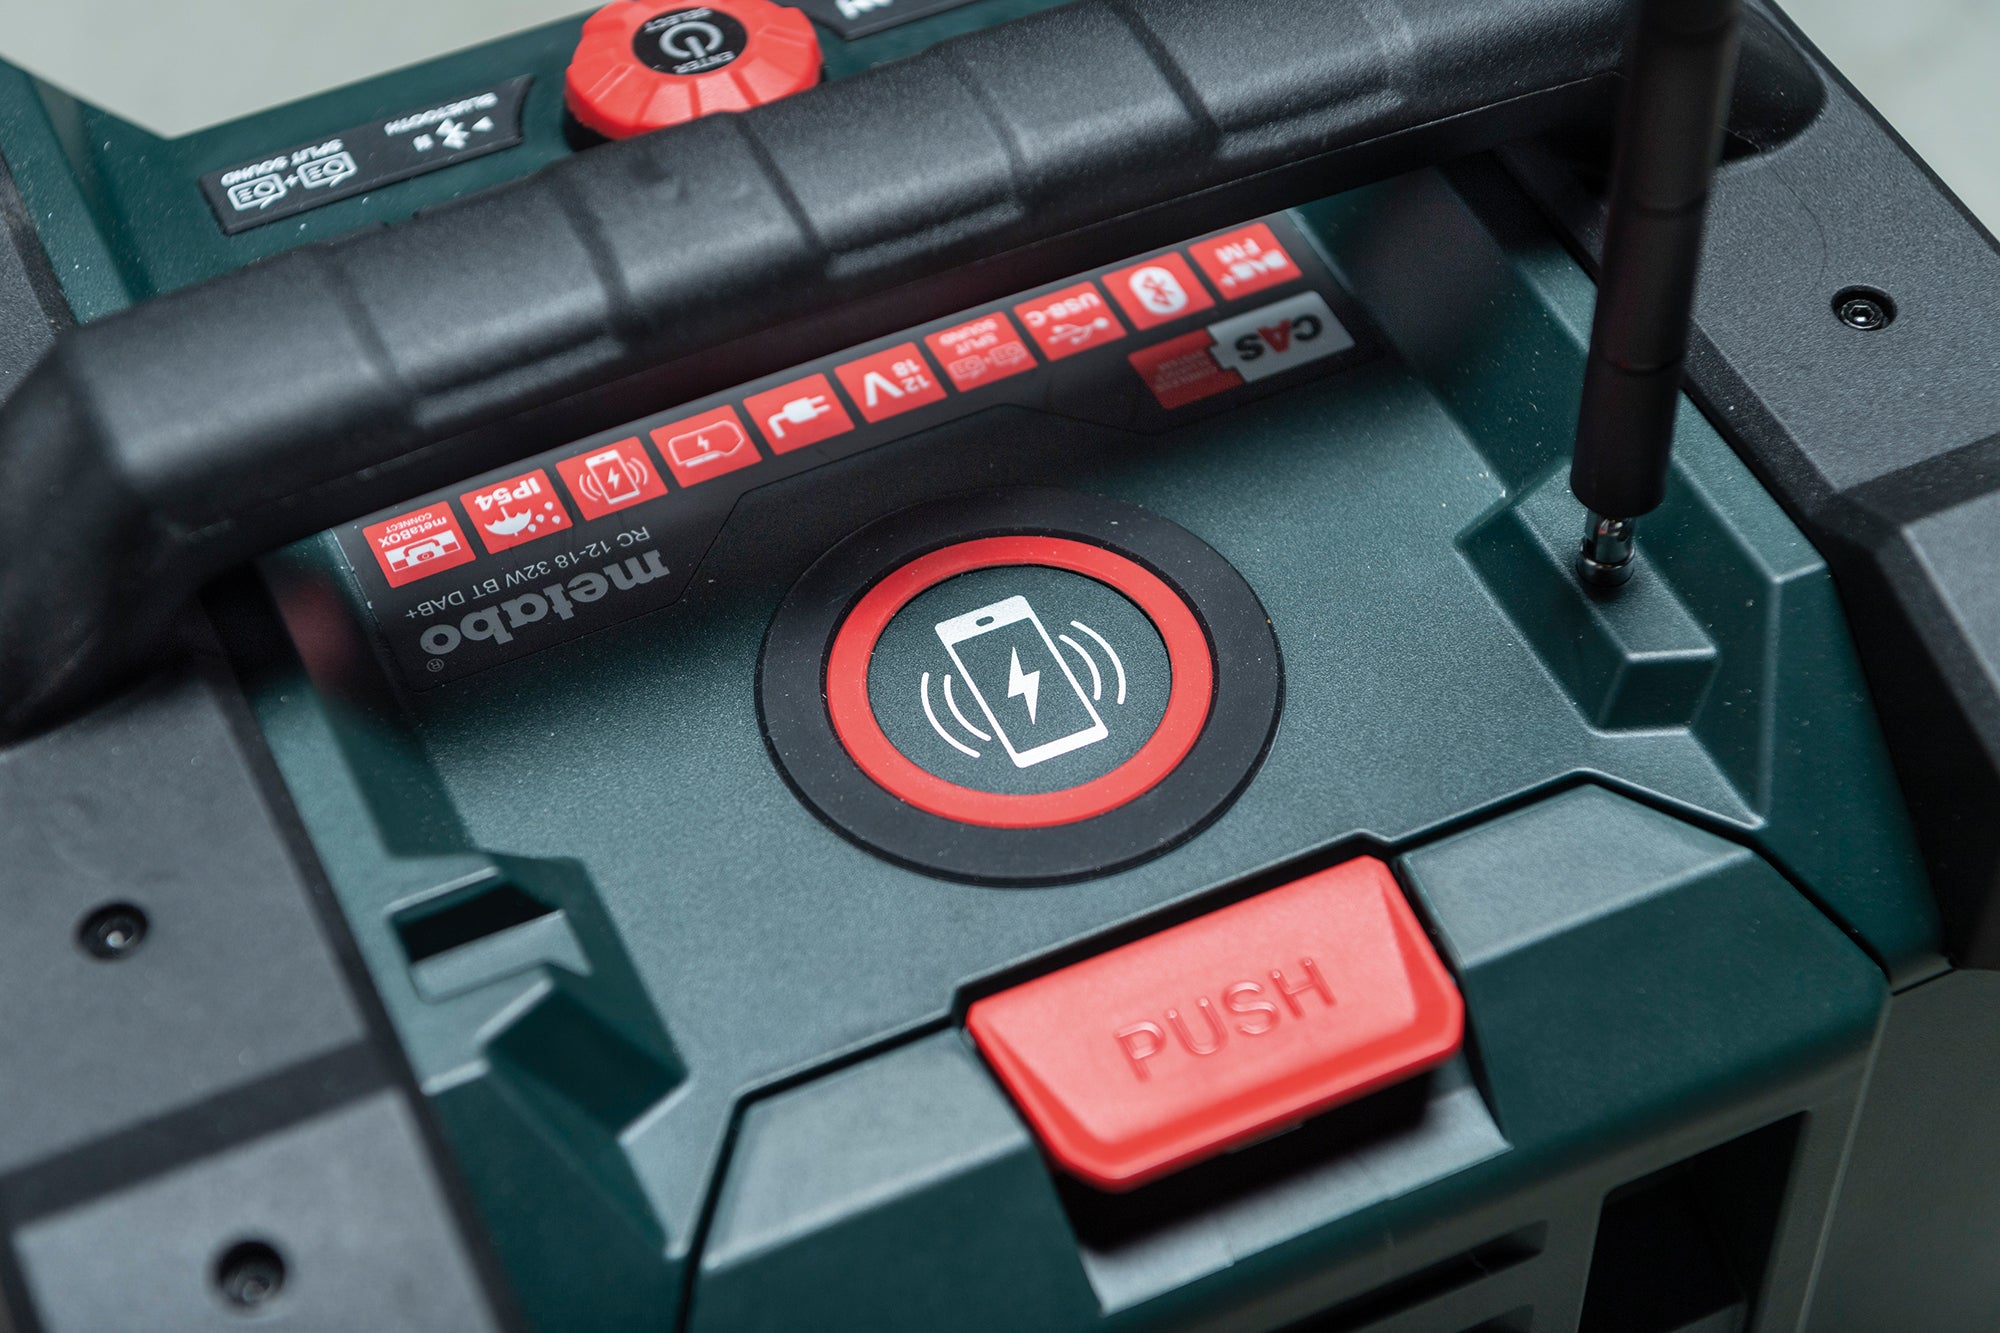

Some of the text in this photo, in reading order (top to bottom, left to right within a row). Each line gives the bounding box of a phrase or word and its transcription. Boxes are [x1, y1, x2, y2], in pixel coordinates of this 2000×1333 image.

[644, 7, 713, 33] SELECT
[673, 51, 735, 74] ENTER
[221, 138, 344, 188] SPLIT SOUND
[1215, 237, 1262, 264] FM
[1024, 292, 1101, 328] USB-C
[956, 333, 998, 355] SPLIT
[1234, 314, 1323, 362] CAS
[891, 358, 921, 376] 18
[863, 370, 904, 407] V
[902, 374, 930, 395] 12
[474, 477, 542, 512] IP54
[378, 516, 447, 548] metaBOX
[385, 512, 433, 533] CONNECT
[404, 526, 650, 619] RC 12-18 32W BT DAB+
[419, 550, 670, 655] metabo
[1114, 958, 1337, 1083] PUSH
